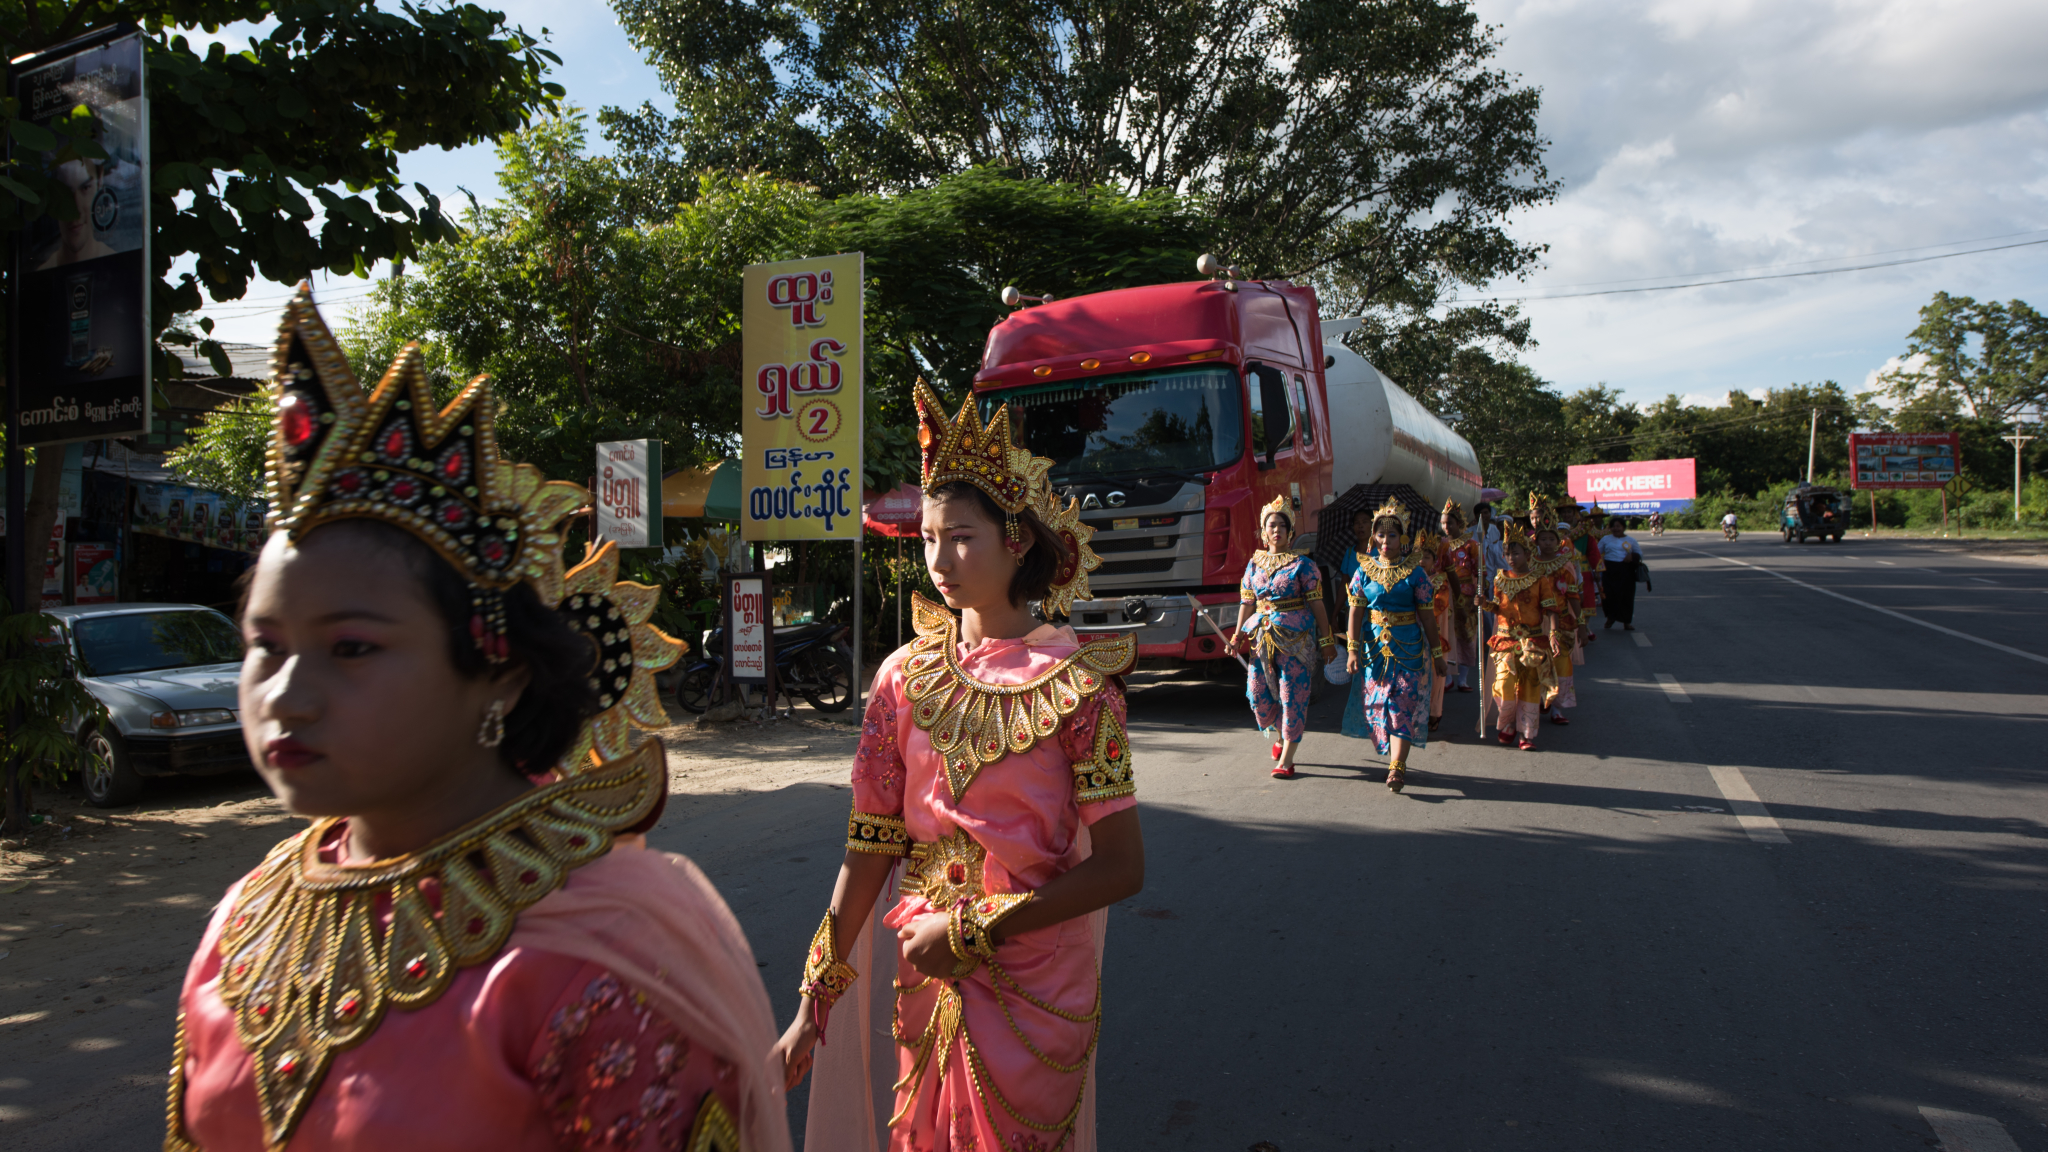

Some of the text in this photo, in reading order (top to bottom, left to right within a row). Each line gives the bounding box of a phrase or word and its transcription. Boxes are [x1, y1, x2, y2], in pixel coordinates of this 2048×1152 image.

[766, 269, 834, 327] ထူး
[756, 337, 848, 418] ရှယ်
[808, 406, 830, 435] 2
[764, 447, 836, 470] မြန်မာ
[749, 467, 852, 532] ထမင်းဆိုင်
[1586, 474, 1672, 492] LOOK HERE !
